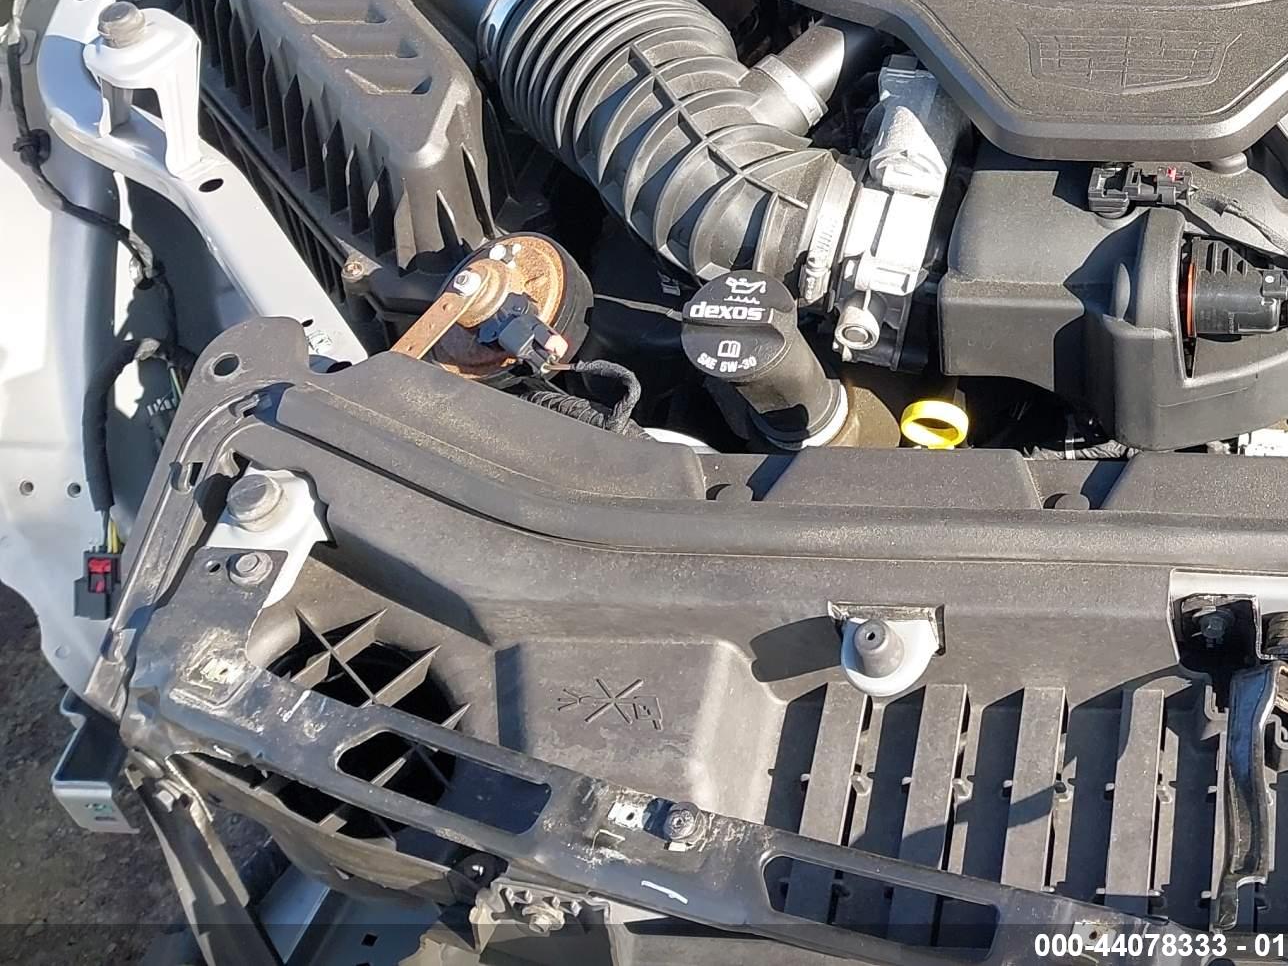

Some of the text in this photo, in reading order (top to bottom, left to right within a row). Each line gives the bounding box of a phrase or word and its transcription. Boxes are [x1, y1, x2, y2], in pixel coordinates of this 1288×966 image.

[690, 301, 766, 320] dexos
[697, 352, 757, 372] SAE 5W-30
